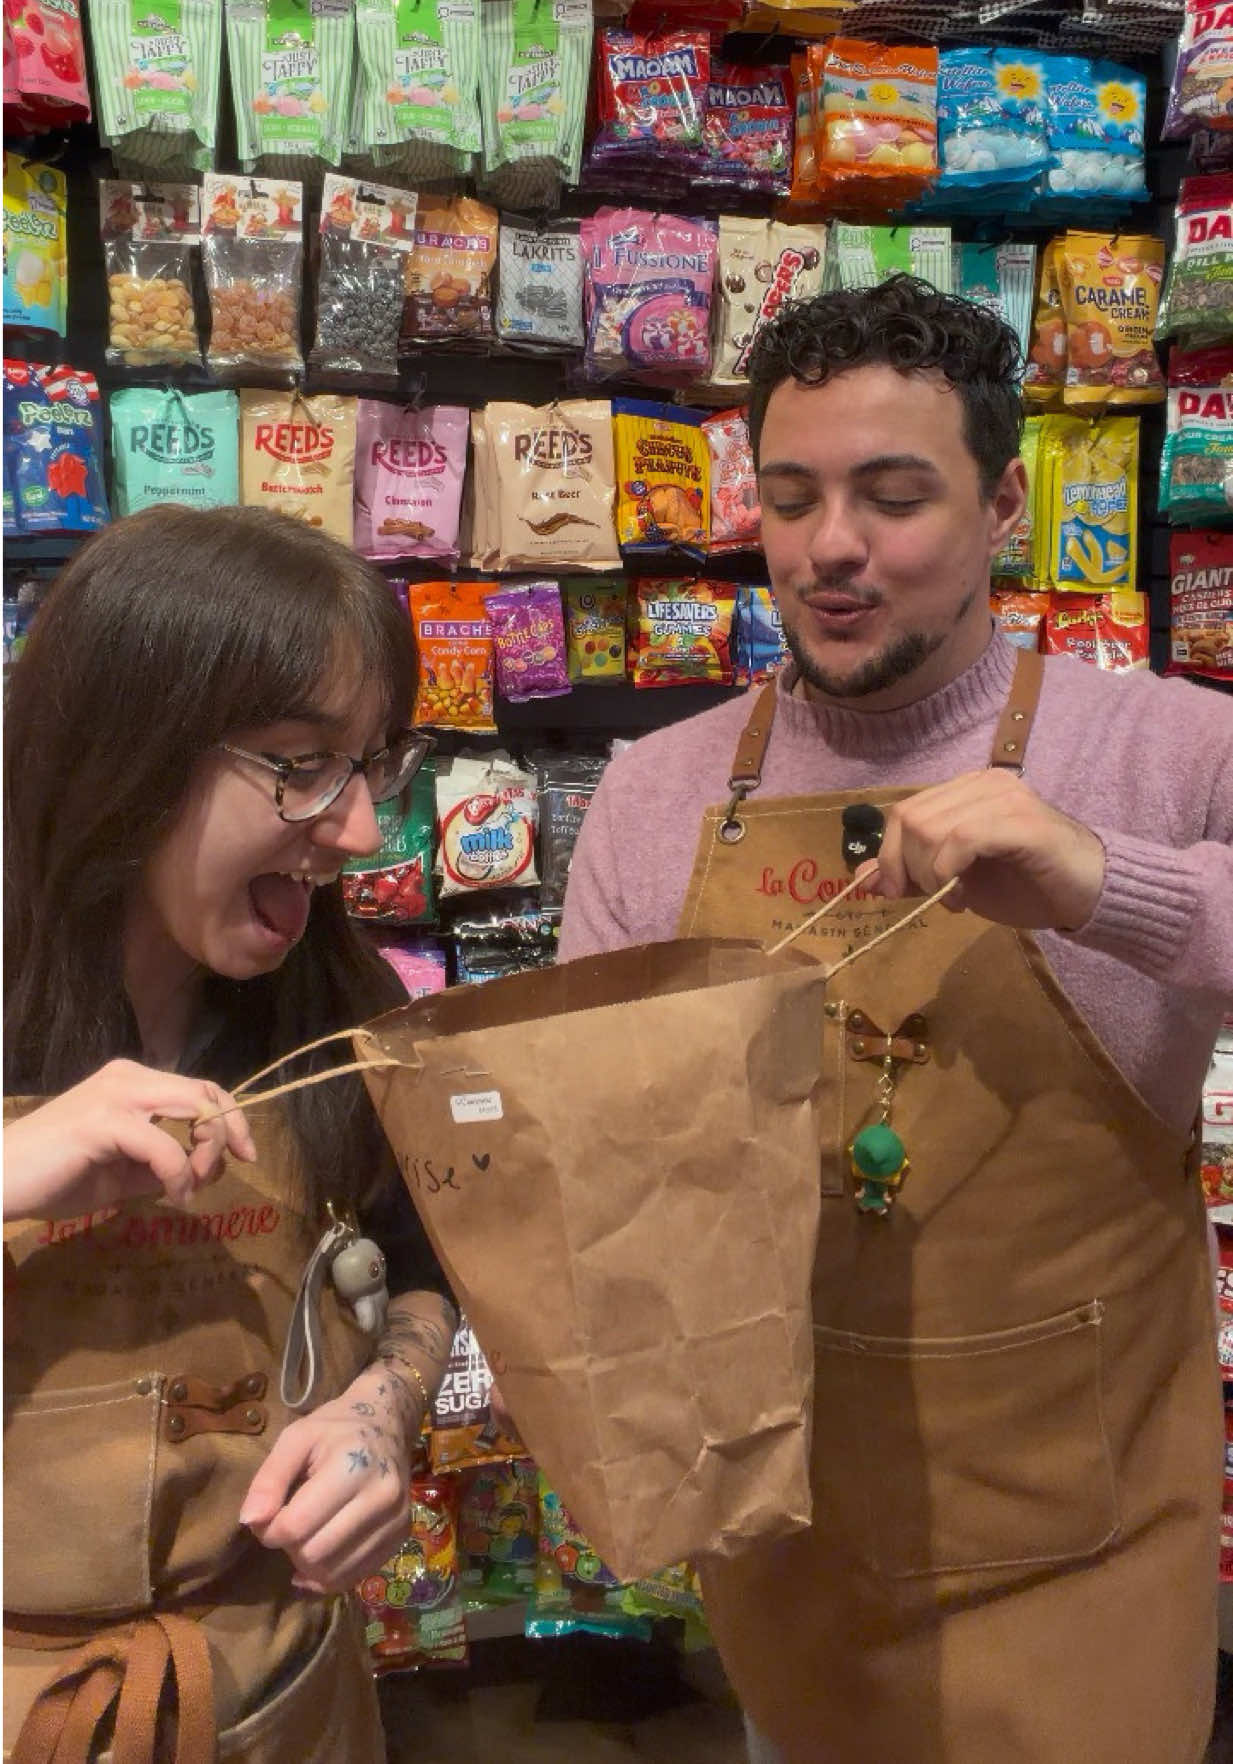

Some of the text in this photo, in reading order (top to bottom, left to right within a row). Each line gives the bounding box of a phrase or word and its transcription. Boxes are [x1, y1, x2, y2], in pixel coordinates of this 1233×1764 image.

[614, 54, 693, 80] MAOAM
[708, 84, 782, 107] MAOAM
[513, 242, 576, 261] LAKRITS
[1178, 391, 1233, 420] DA
[130, 423, 215, 454] REED'S
[254, 422, 335, 454] REED'S
[514, 429, 593, 461] REED'S
[371, 438, 448, 468] REED'S
[143, 484, 205, 497] Peppermint
[558, 489, 581, 499] Beer
[1171, 568, 1233, 596] GIANT
[431, 645, 487, 657] Candy Corn
[460, 827, 514, 853] milk
[771, 919, 846, 938] MAASIN
[438, 1369, 494, 1398] ZER
[435, 1391, 492, 1416] SUGA
